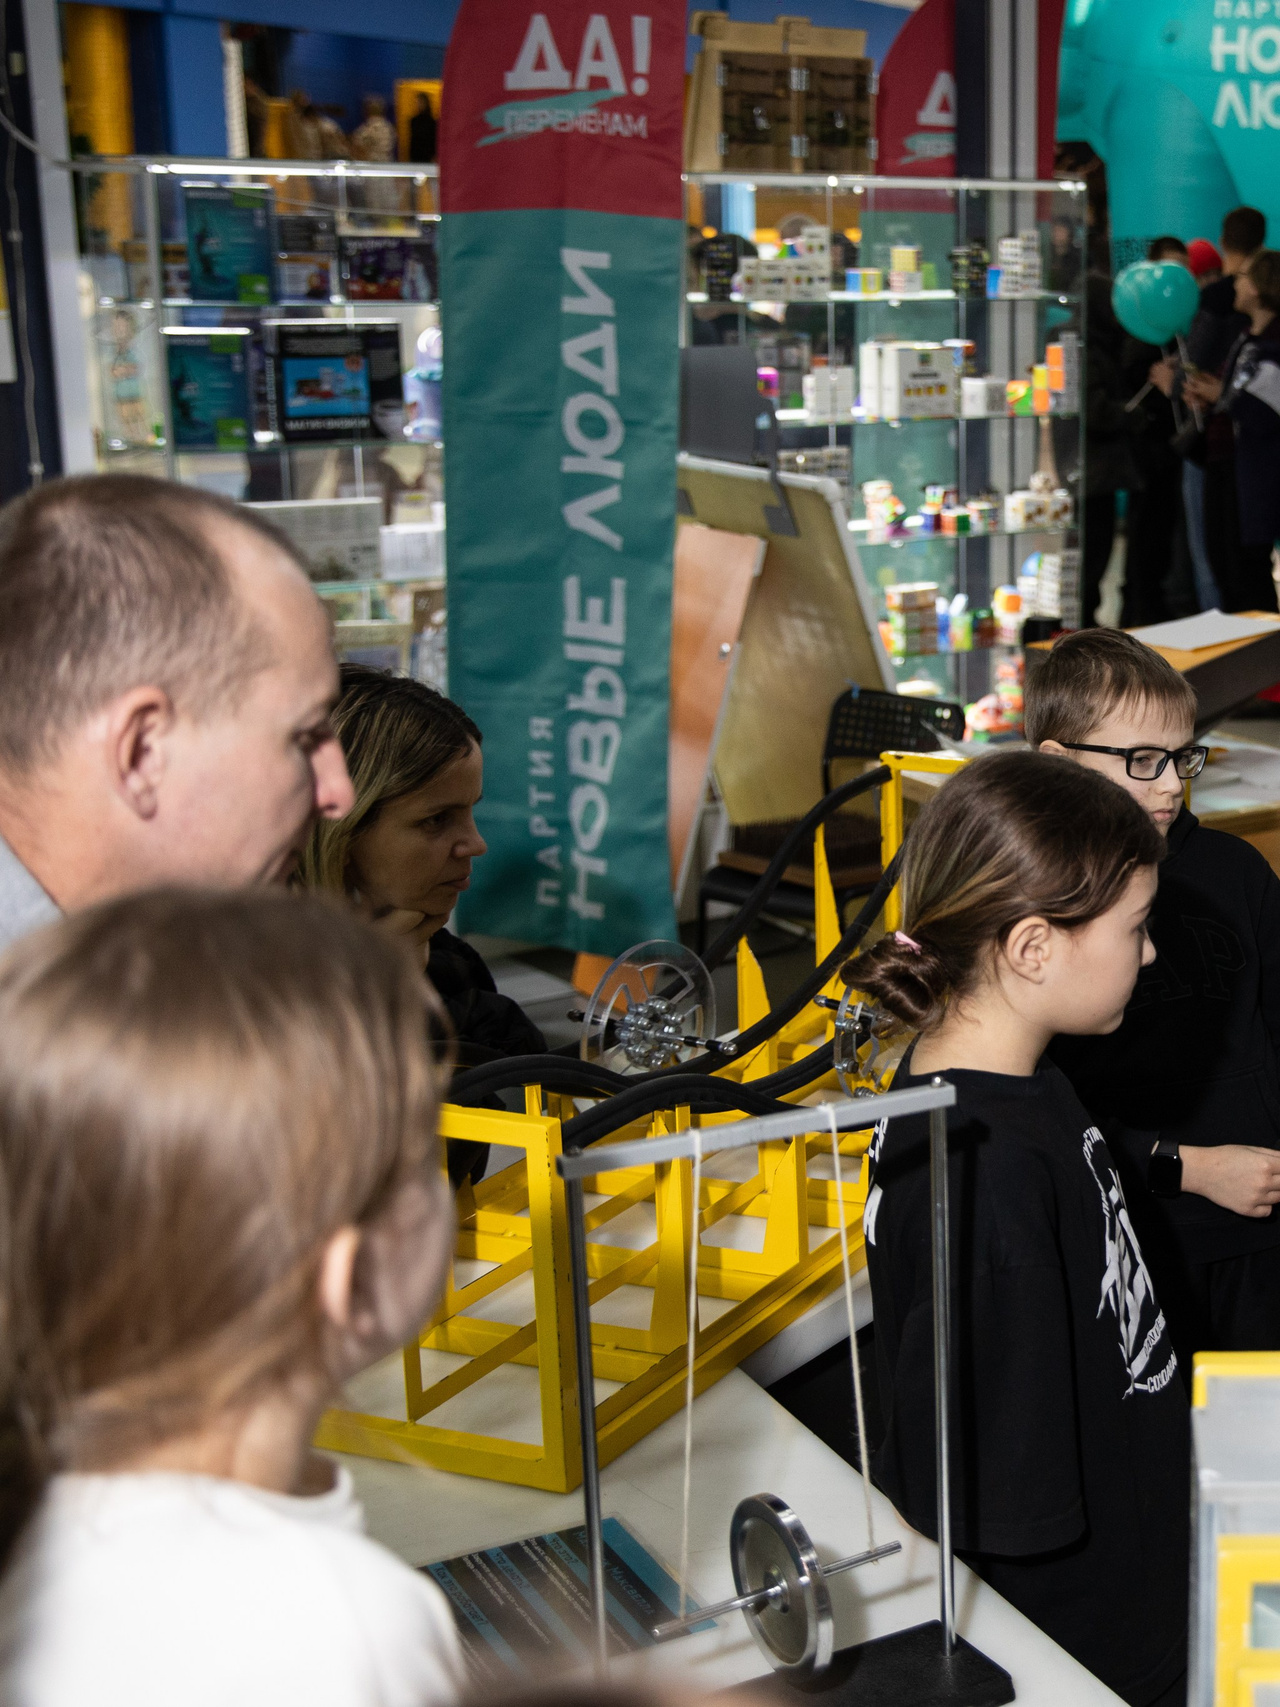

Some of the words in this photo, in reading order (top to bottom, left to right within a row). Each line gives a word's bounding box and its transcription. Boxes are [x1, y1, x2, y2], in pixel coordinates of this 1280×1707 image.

[503, 108, 648, 138] ПЕРЕМЕНАМ
[504, 13, 651, 96] ДА!
[561, 247, 626, 551] ЛЮДИ
[529, 716, 562, 907] ПАРТИЯ
[563, 575, 627, 920] НОВЫЕ
